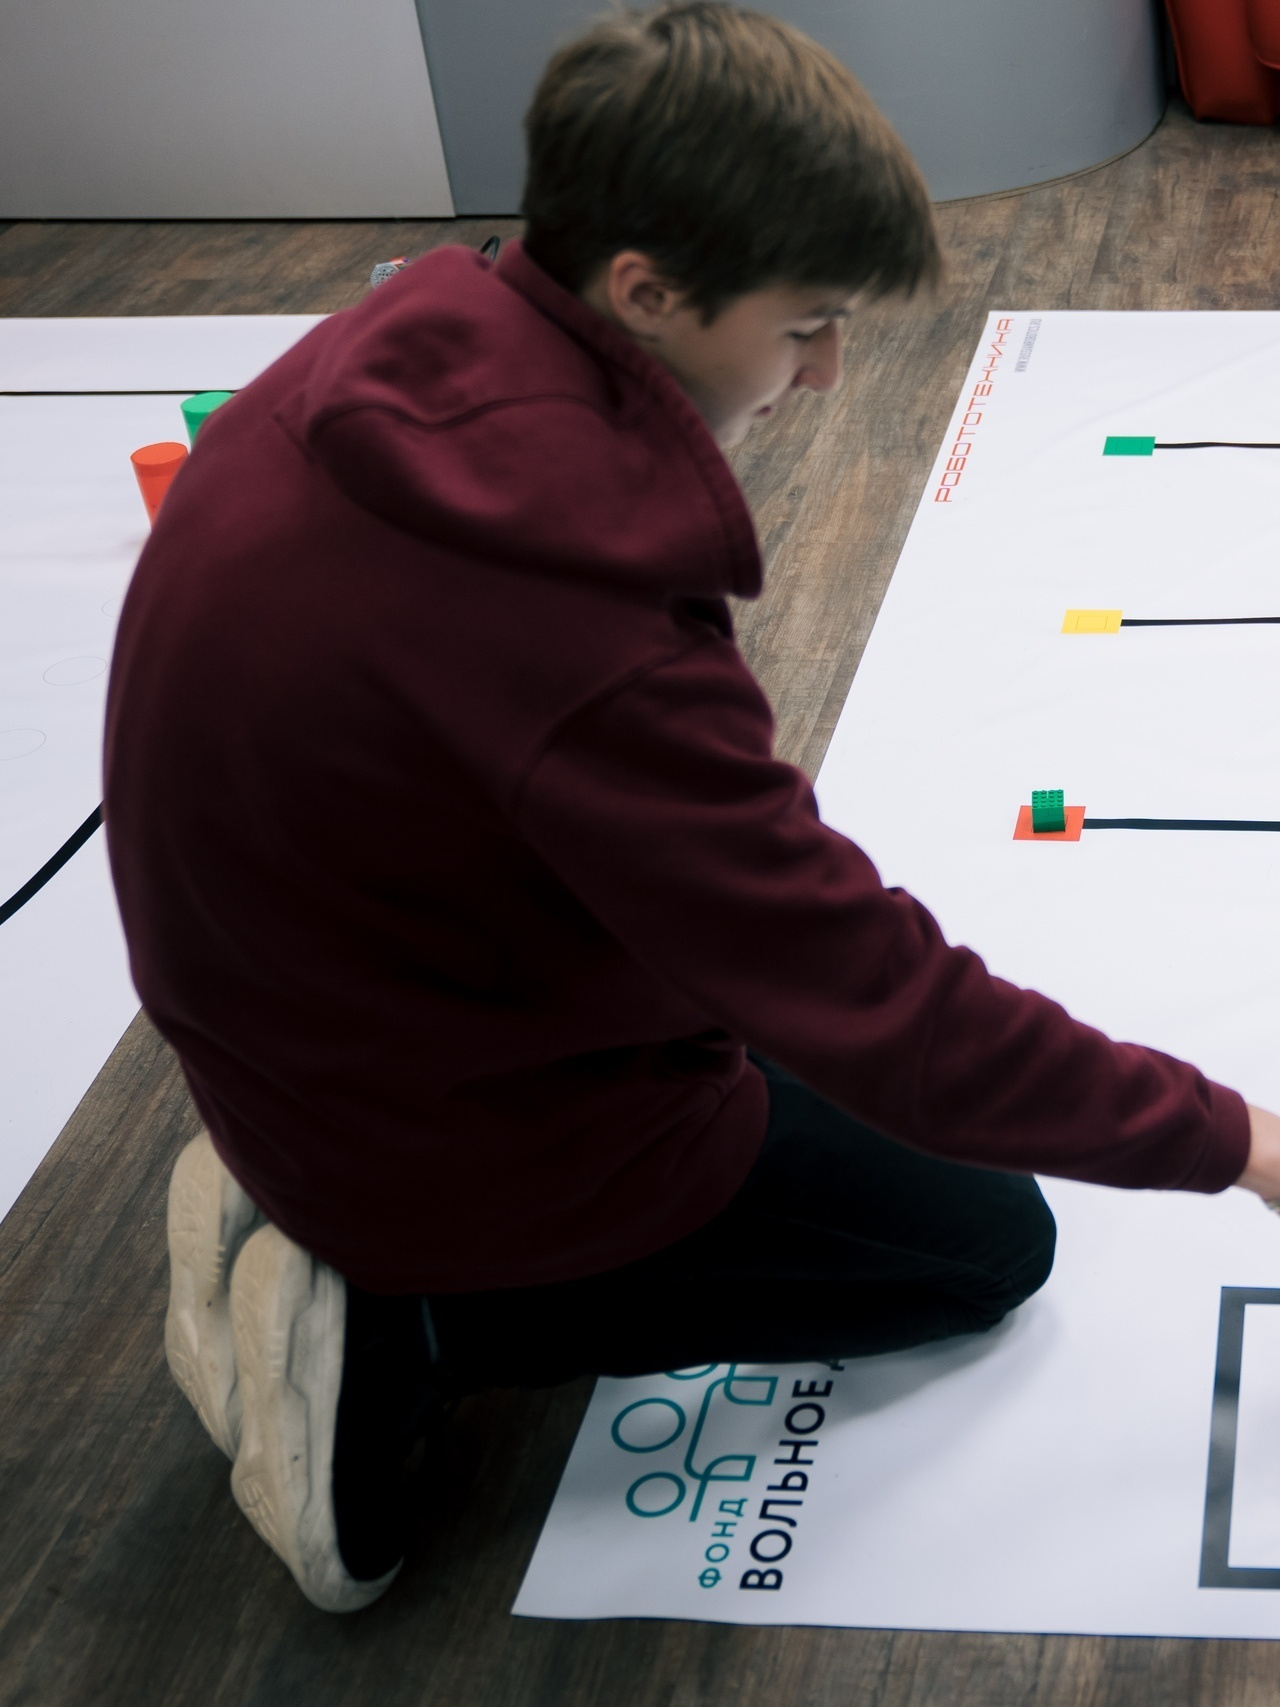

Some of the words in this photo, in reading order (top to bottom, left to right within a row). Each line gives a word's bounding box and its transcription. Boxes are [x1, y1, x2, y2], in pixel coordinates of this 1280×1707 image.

[934, 318, 1015, 503] РОБОТОТЕХНИКА
[698, 1497, 748, 1590] ФОНД
[739, 1379, 834, 1591] ВОЛЬНОЕ
